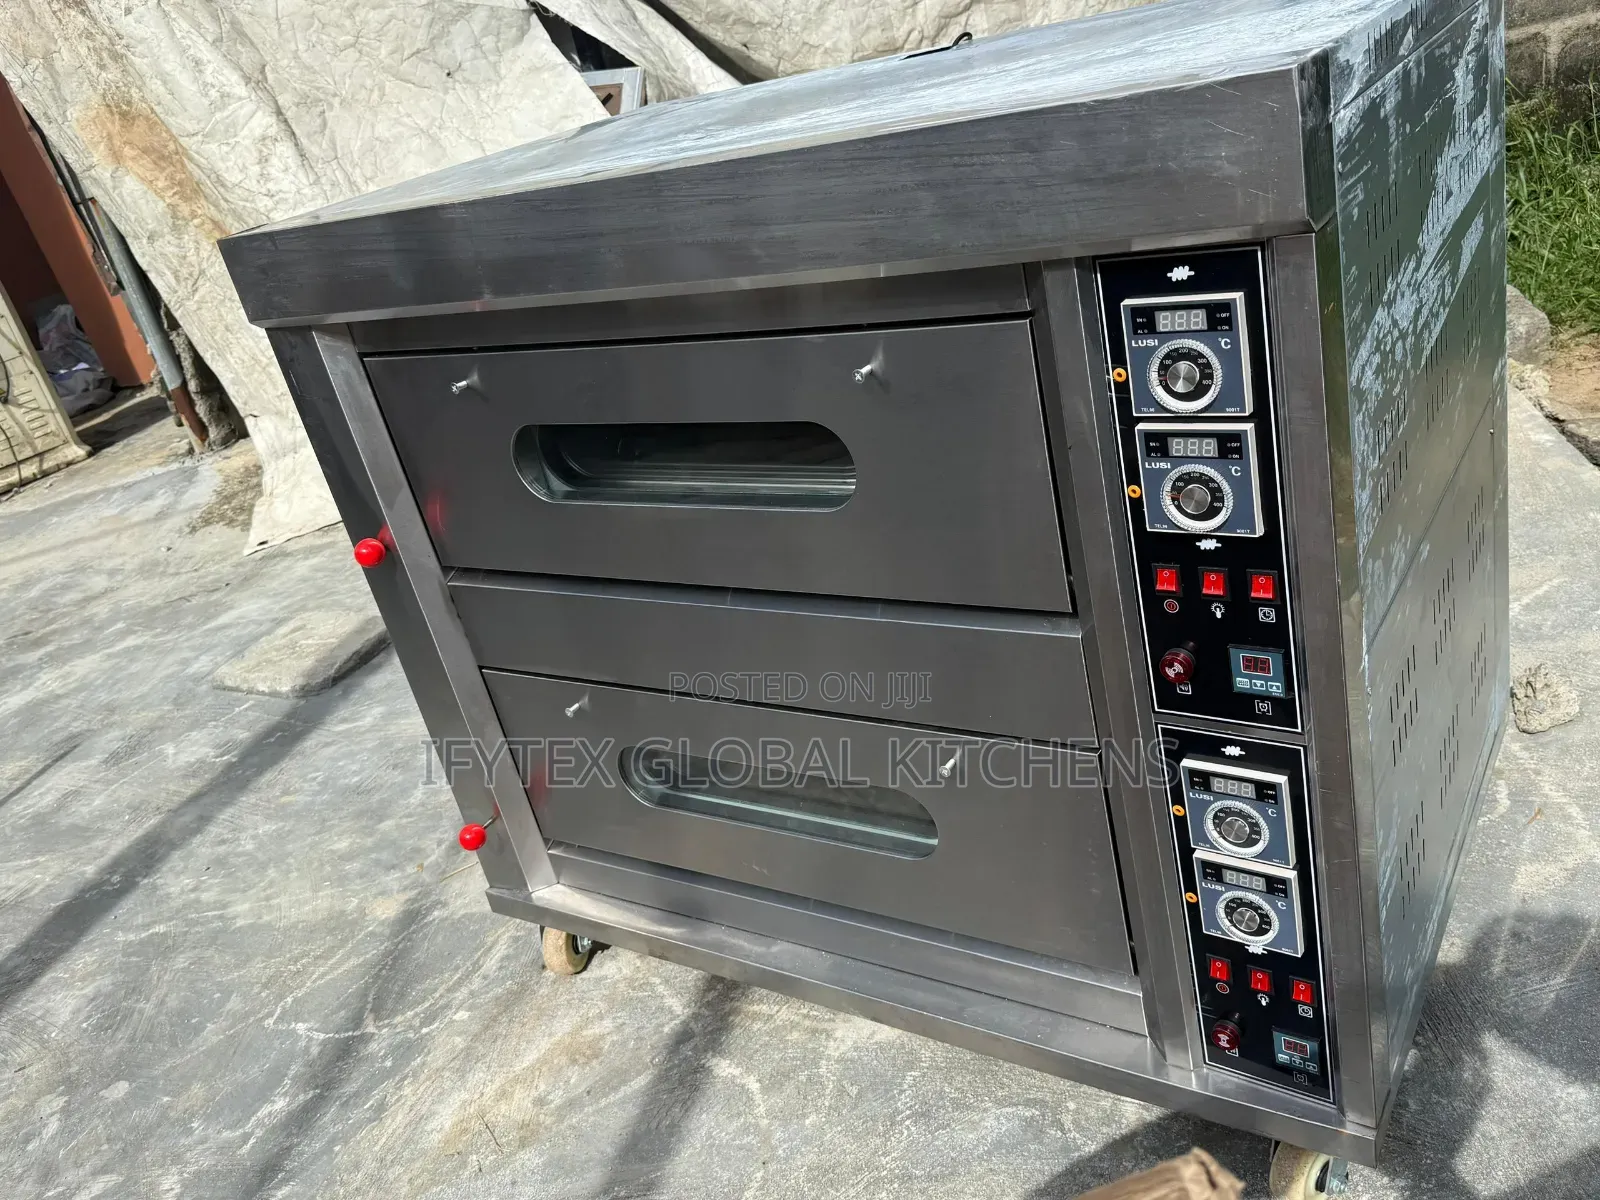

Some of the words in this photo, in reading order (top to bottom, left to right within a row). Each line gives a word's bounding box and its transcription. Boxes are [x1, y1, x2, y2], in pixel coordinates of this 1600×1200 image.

[1131, 339, 1158, 347] LUSI
[1189, 792, 1214, 801] LUSI
[1202, 882, 1225, 891] LUSI
